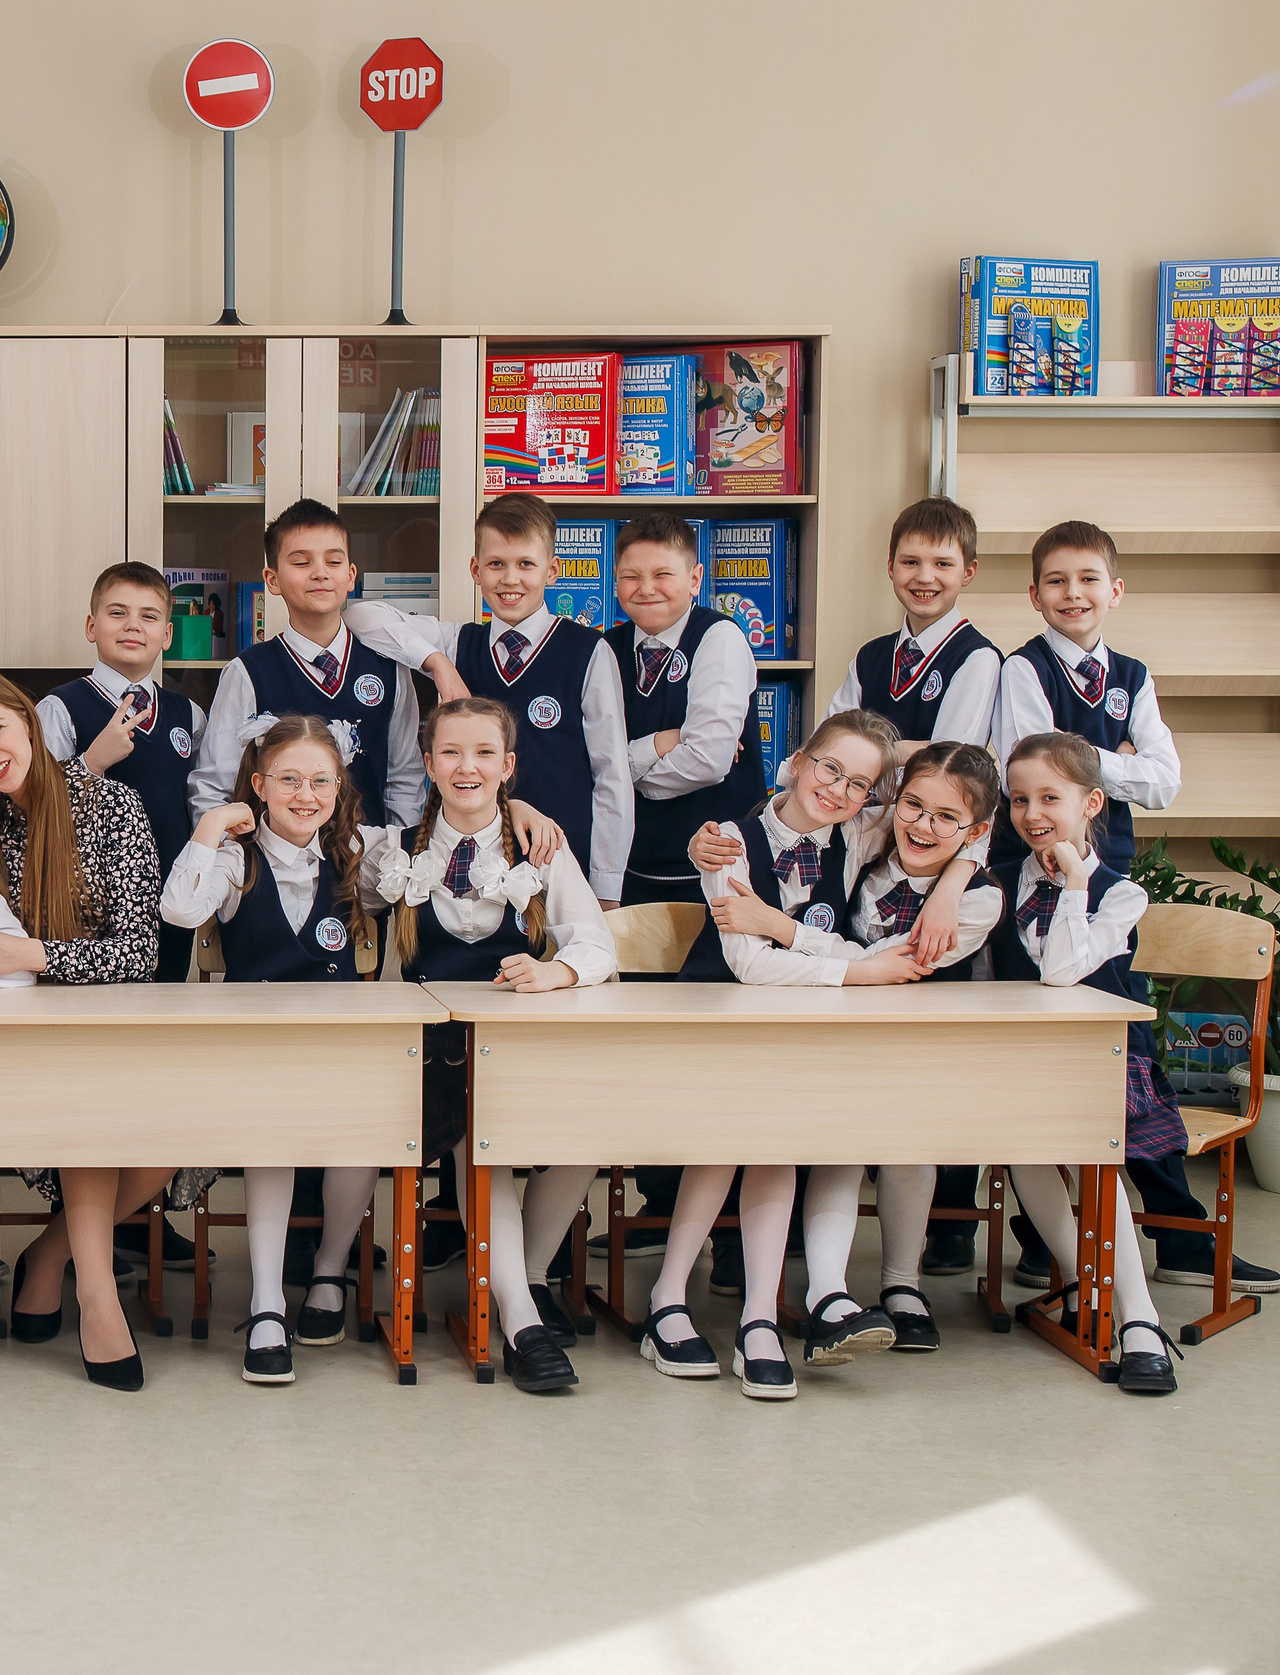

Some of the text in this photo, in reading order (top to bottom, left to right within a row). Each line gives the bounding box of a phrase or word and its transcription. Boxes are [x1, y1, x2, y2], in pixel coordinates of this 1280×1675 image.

[368, 66, 436, 103] STOP
[1030, 266, 1090, 283] КОМПЛЕКТ
[1220, 266, 1280, 282] КОМПЛЕ
[993, 296, 1088, 318] МАМАТИКА
[1173, 298, 1280, 319] МАТЕМАТИК
[494, 365, 516, 373] ФГОС
[533, 361, 604, 377] КОМПЛЕКТ
[492, 374, 526, 384] спектр
[532, 381, 603, 390] ДЛЯ НАЧАЛЬНОЙ ШКОЛЫ
[990, 376, 1005, 386] 24
[556, 394, 600, 412] ЯЗЫК
[486, 475, 502, 484] 364
[578, 547, 602, 555] ШКОЛЫ
[717, 547, 748, 555] НАЧАЛЬНОЙ
[716, 559, 769, 577] АТИКА
[201, 572, 227, 581] ПОСОБИЕ
[363, 683, 377, 696] 15
[1111, 697, 1124, 710] 15
[537, 705, 552, 718] 15
[814, 914, 827, 927] 15
[325, 928, 339, 941] 15
[1228, 1029, 1242, 1041] 60
